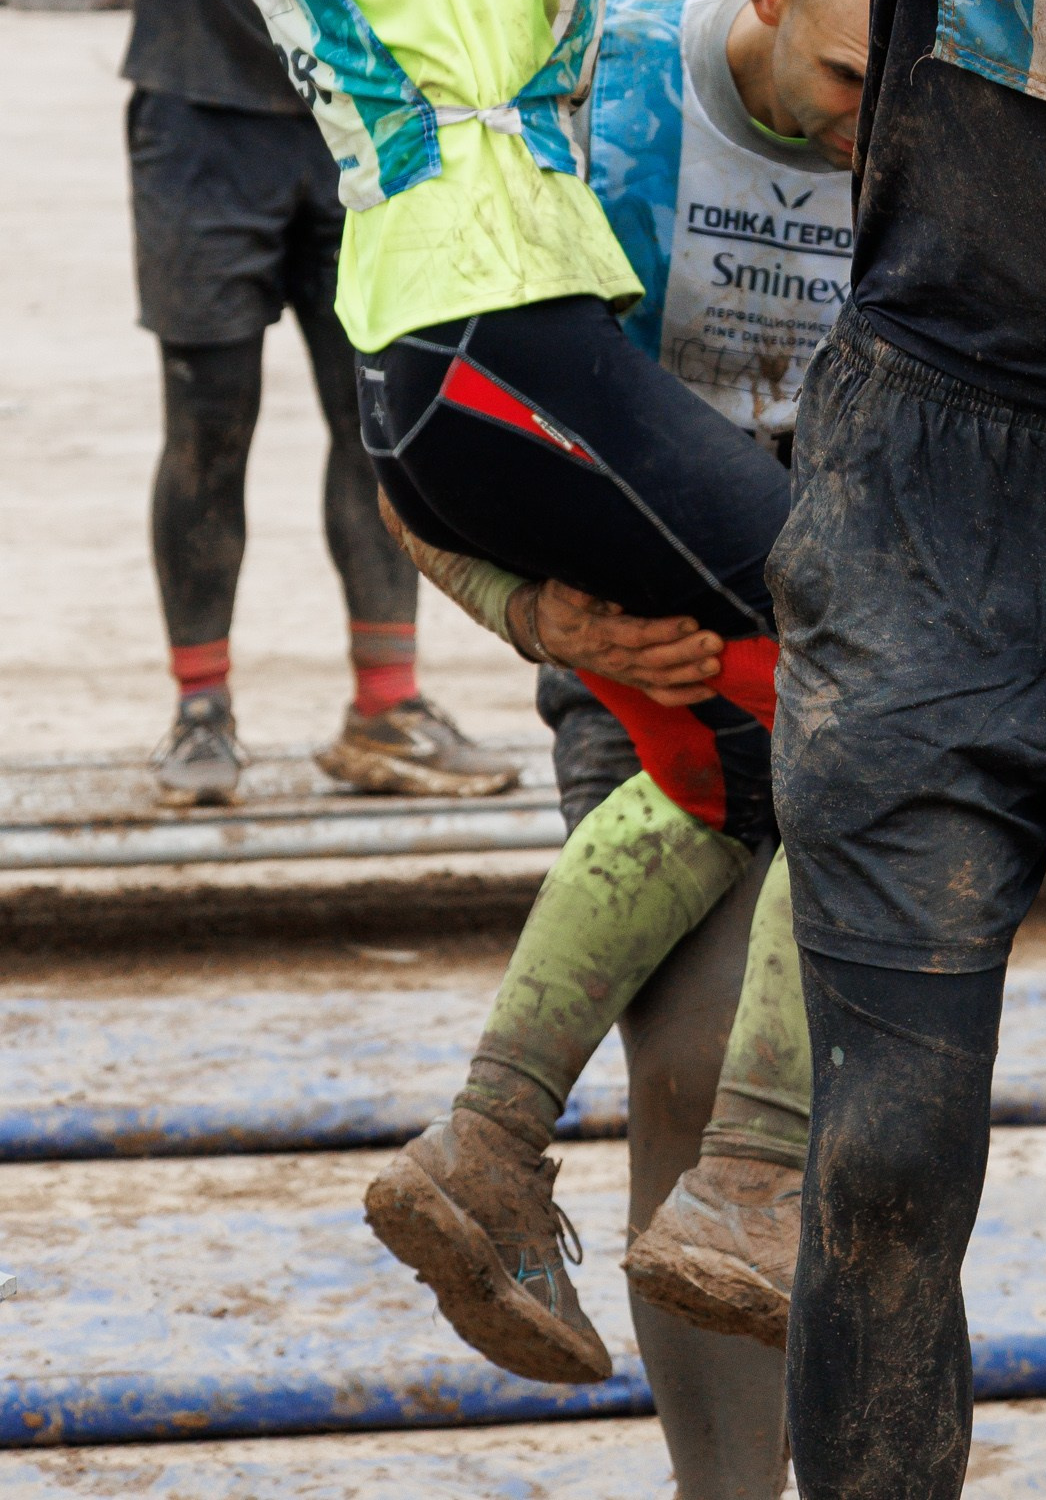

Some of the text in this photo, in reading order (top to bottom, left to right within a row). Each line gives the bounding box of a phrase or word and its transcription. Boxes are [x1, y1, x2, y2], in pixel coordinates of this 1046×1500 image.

[688, 203, 776, 238] ГОНКА
[711, 252, 851, 305] Sminex
[703, 324, 736, 339] FINE
